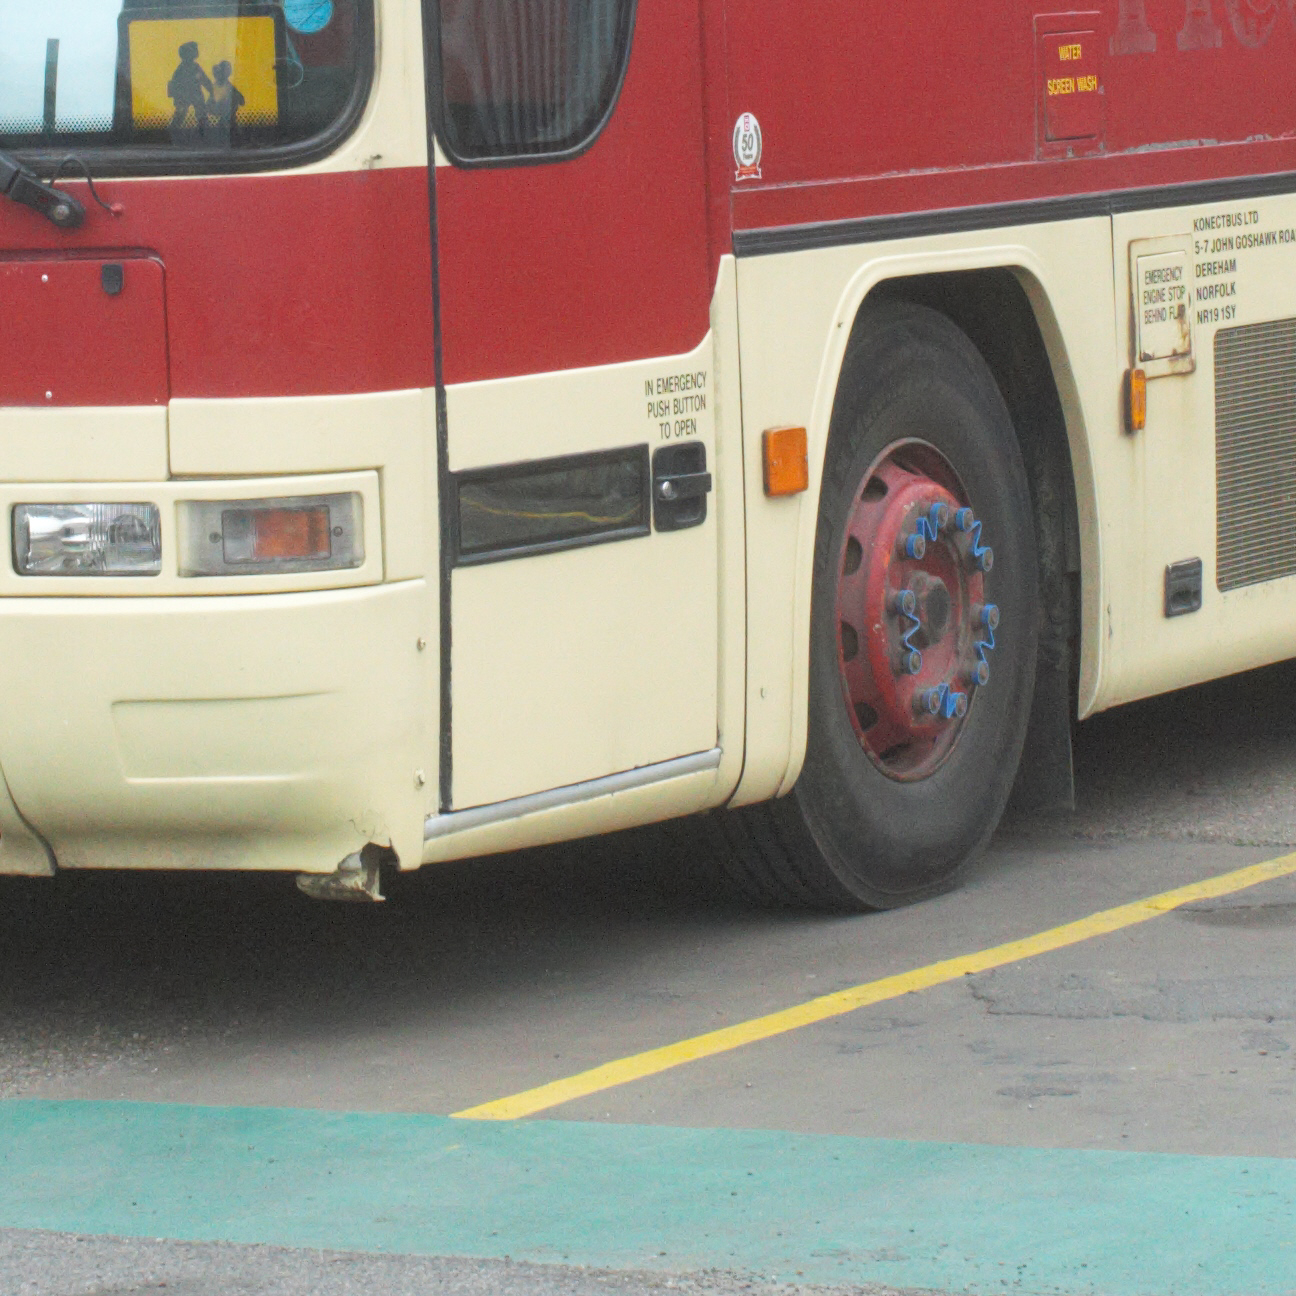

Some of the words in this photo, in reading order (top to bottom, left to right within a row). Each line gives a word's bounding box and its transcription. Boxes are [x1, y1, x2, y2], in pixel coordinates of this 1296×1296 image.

[1058, 44, 1082, 60] WATER
[1047, 77, 1075, 95] SCREEN
[1076, 75, 1097, 92] WASH
[742, 133, 754, 151] 50
[1193, 212, 1243, 232] KONECTBUS
[1244, 210, 1259, 225] LTD
[1195, 239, 1209, 255] 5-7
[1211, 236, 1234, 253] JOHN
[1235, 231, 1277, 250] GOSHAWK
[1144, 266, 1182, 285] EMERGENCY
[1195, 258, 1237, 278] DEREHAM
[1143, 288, 1166, 305] ENGINE
[1168, 285, 1186, 301] STOP
[1196, 282, 1236, 301] NORFOLK
[1144, 307, 1167, 324] BEHIND
[1168, 303, 1186, 321] FL
[1197, 307, 1219, 324] NR19
[644, 379, 654, 396] IN
[656, 371, 707, 395] EMERGENCY
[647, 399, 671, 418] PUSH
[673, 394, 707, 415] BUTTON
[659, 421, 671, 439] TO
[674, 417, 697, 437] OPEN
